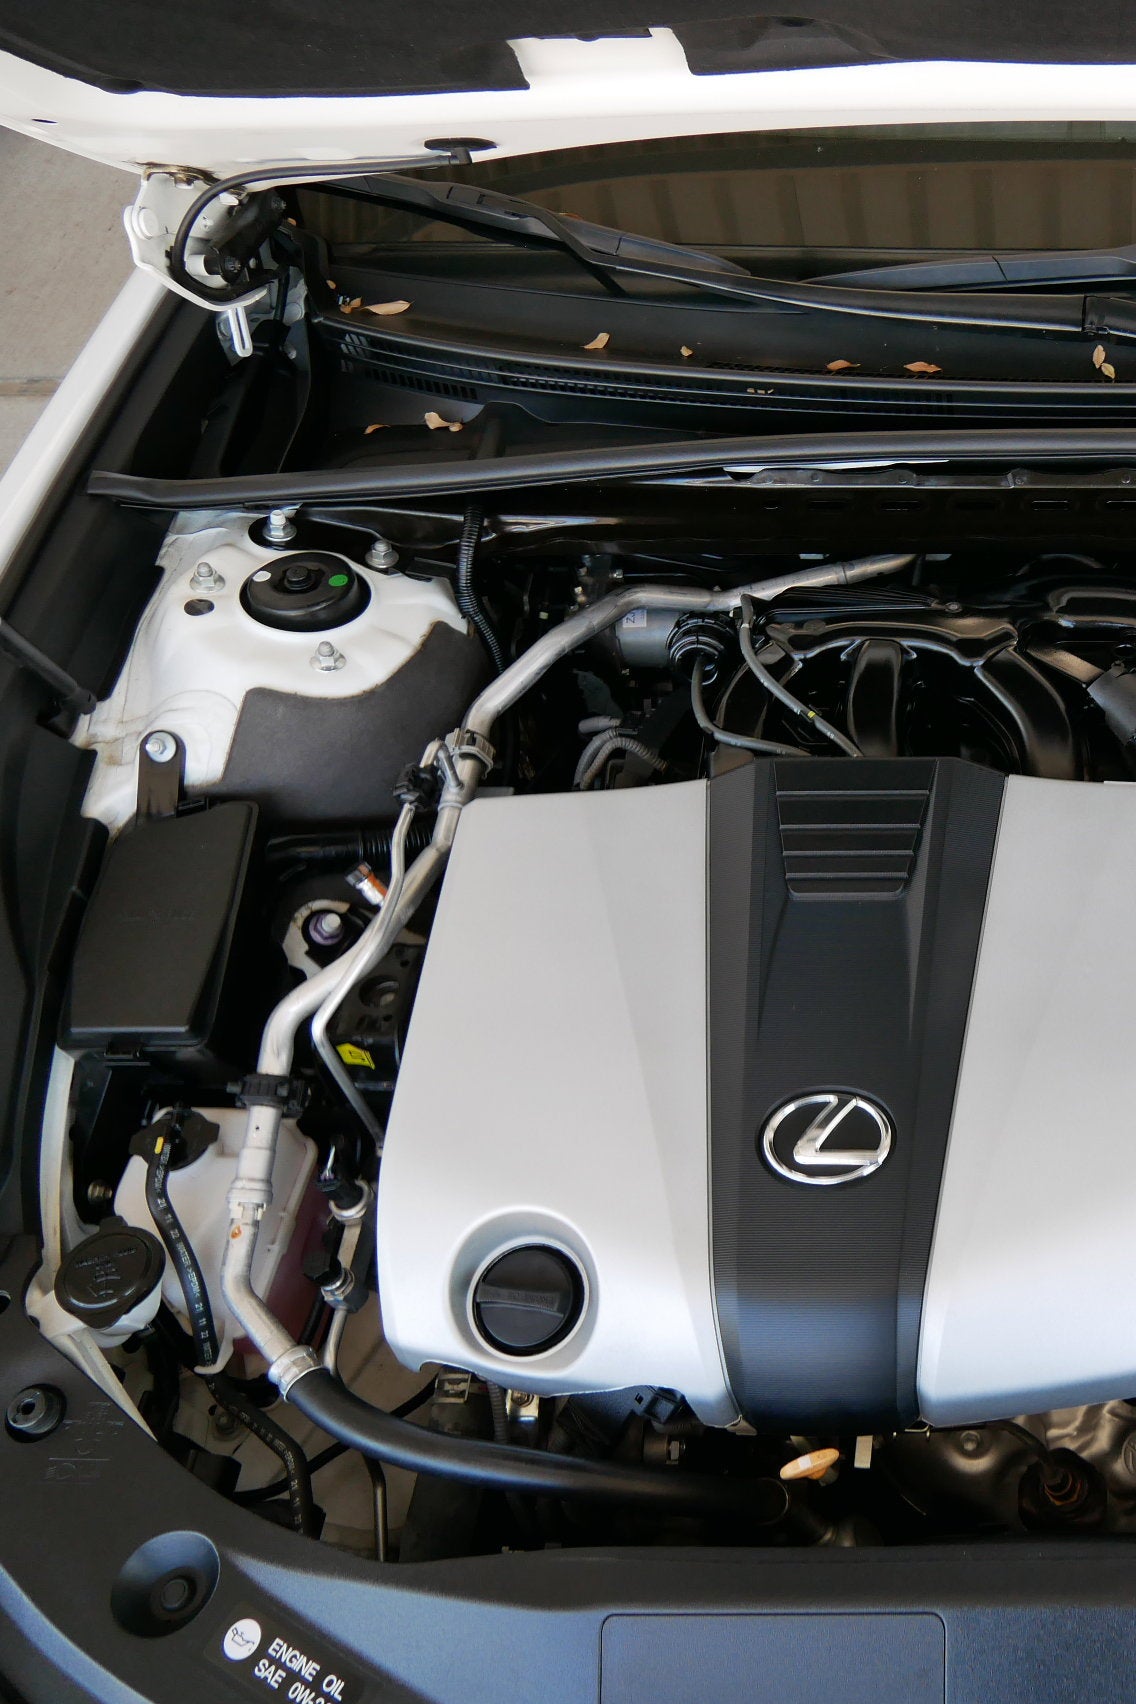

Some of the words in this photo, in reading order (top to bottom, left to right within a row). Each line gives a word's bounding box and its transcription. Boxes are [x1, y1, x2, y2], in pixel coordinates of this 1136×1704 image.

[176, 1241, 192, 1268] WATER
[254, 1658, 287, 1690] SAE
[288, 1681, 334, 1704] 0W-
[268, 1637, 320, 1681] ENGINE
[322, 1674, 345, 1702] OIL
